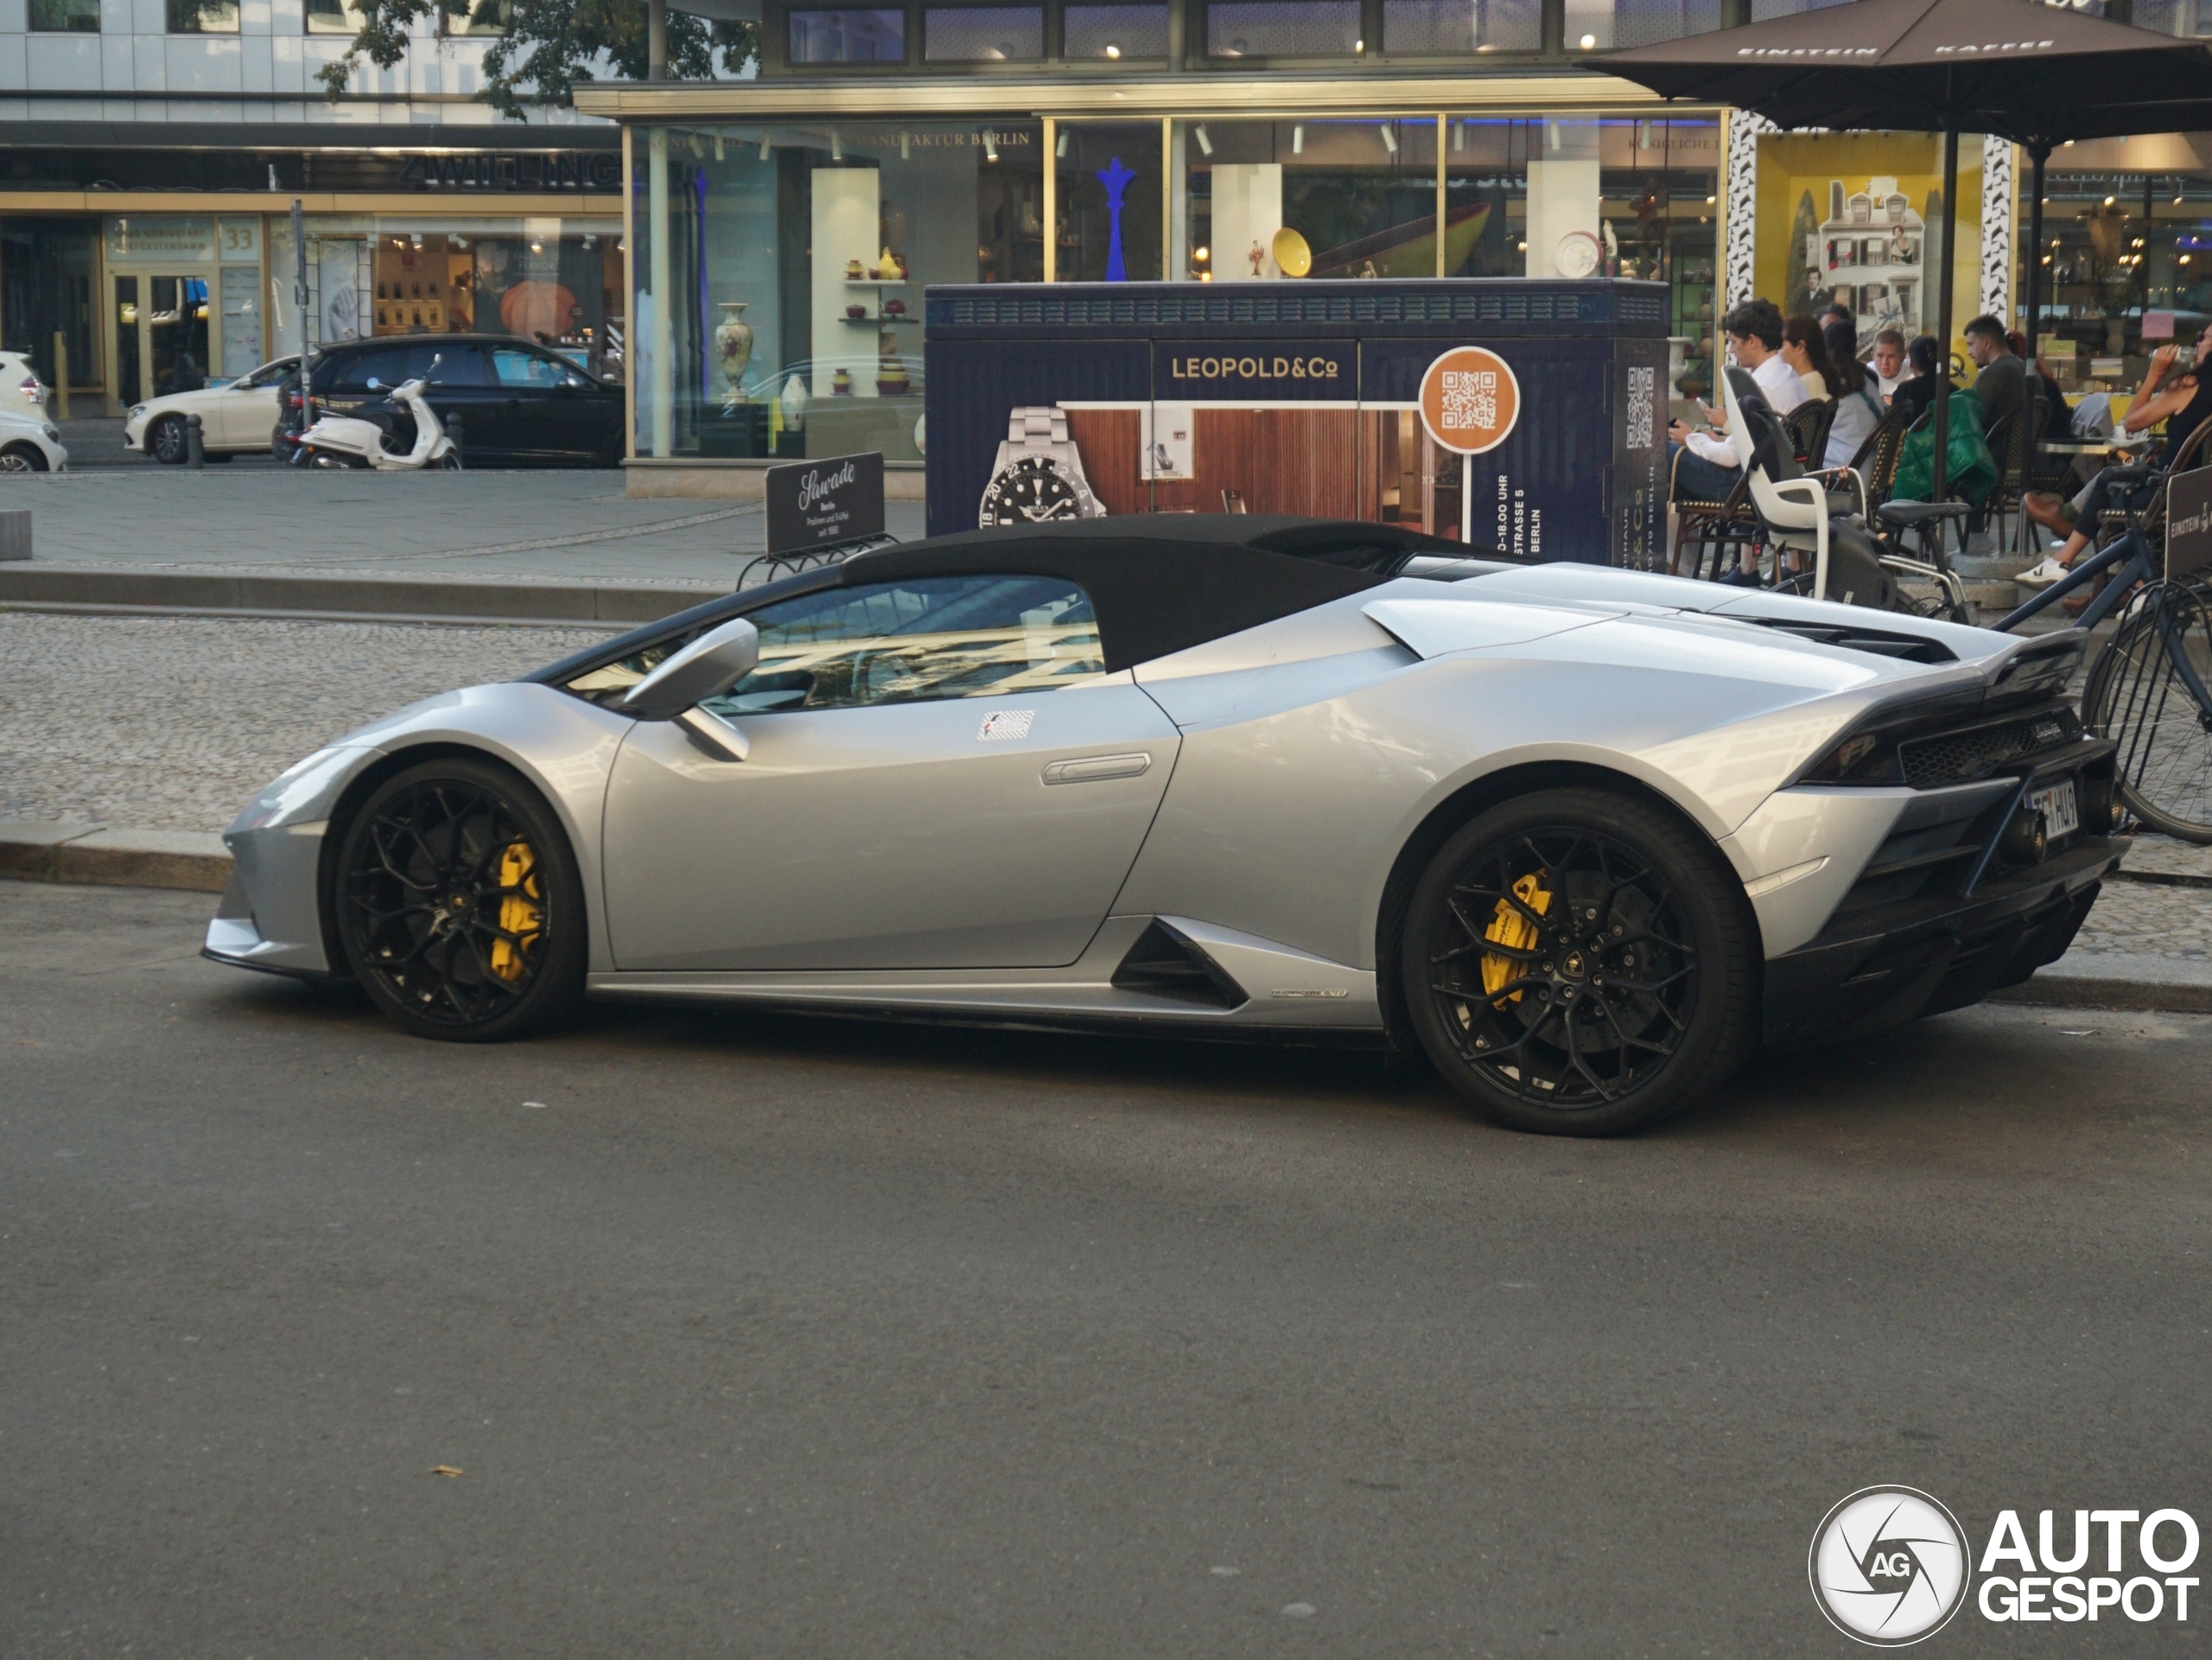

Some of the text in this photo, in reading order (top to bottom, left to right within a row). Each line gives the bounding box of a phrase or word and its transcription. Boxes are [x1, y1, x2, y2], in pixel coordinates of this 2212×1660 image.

[1934, 40, 2055, 53] KAFFEE
[970, 132, 1030, 145] BERLIN
[398, 153, 620, 187] ZWILLING
[226, 228, 252, 251] 33
[1005, 463, 1021, 480] 22
[1058, 466, 1070, 478] 2
[798, 461, 855, 511] Sawade
[988, 483, 1001, 501] 20
[1077, 488, 1089, 499] 4
[1498, 474, 1508, 500] UHR
[982, 512, 993, 526] 18
[1514, 500, 1524, 555] STRASSE
[2171, 515, 2200, 538] EINSTEIN
[1530, 509, 1541, 553] BERLIN
